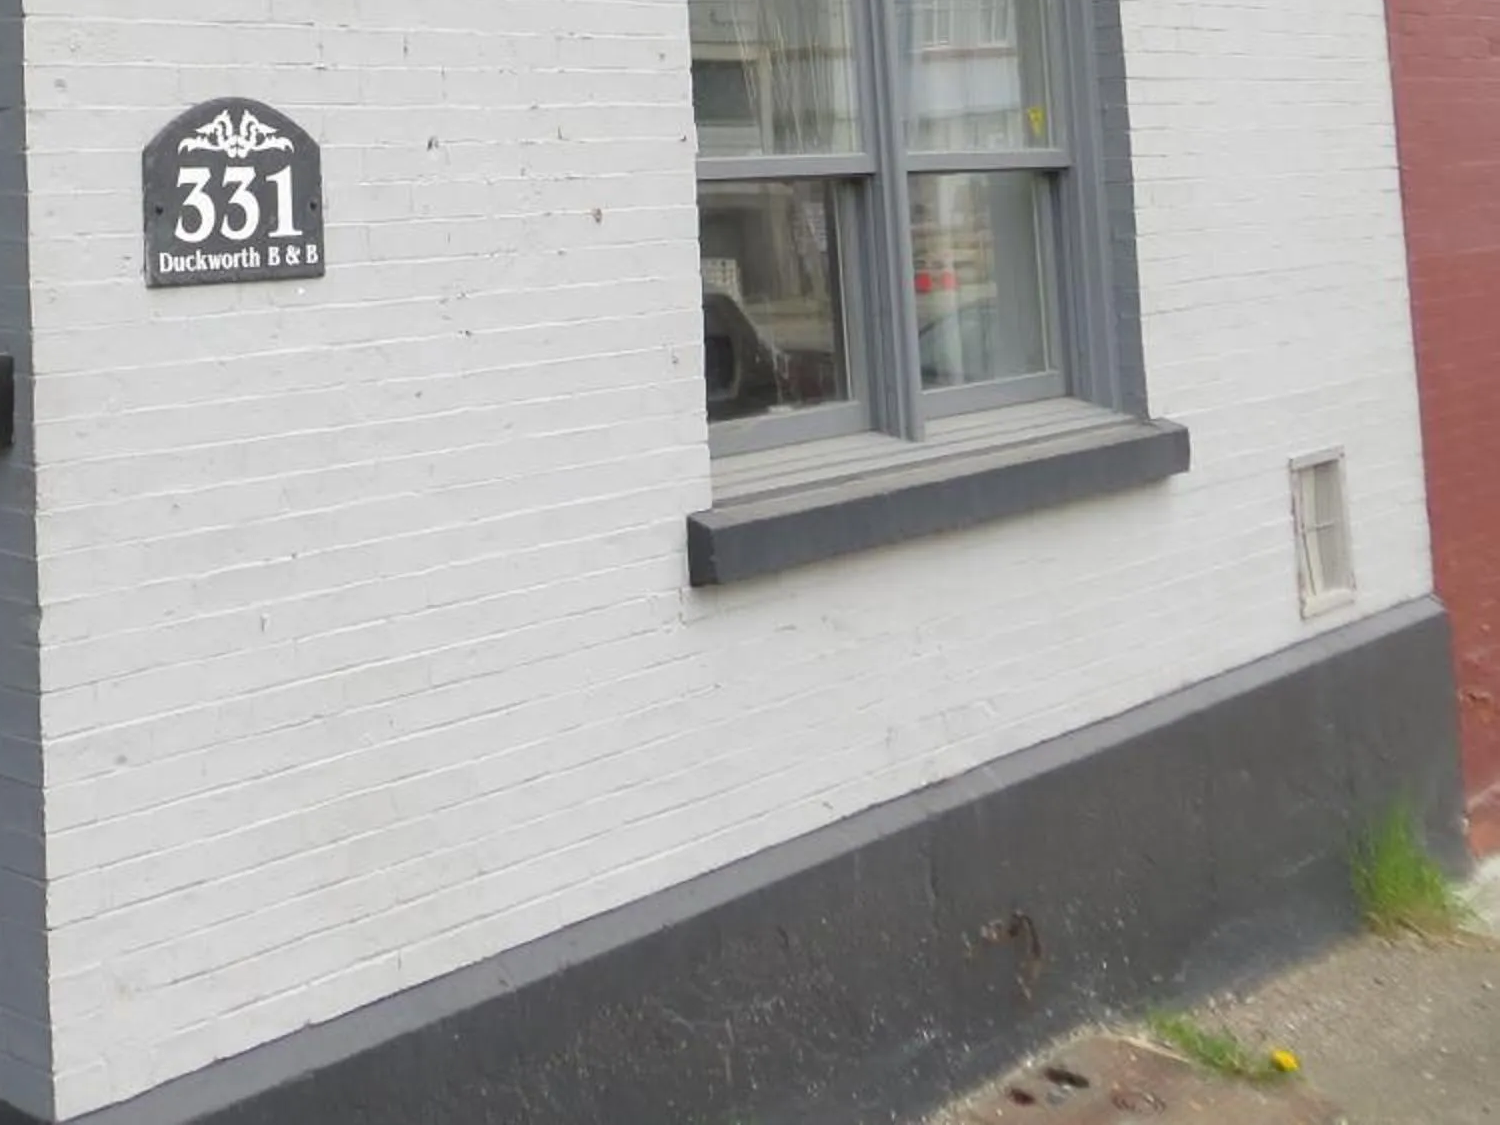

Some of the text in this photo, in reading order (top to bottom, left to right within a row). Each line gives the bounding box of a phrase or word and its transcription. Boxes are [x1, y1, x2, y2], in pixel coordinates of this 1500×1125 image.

[174, 164, 303, 243] 331
[159, 244, 319, 273] Duckworth B & B
